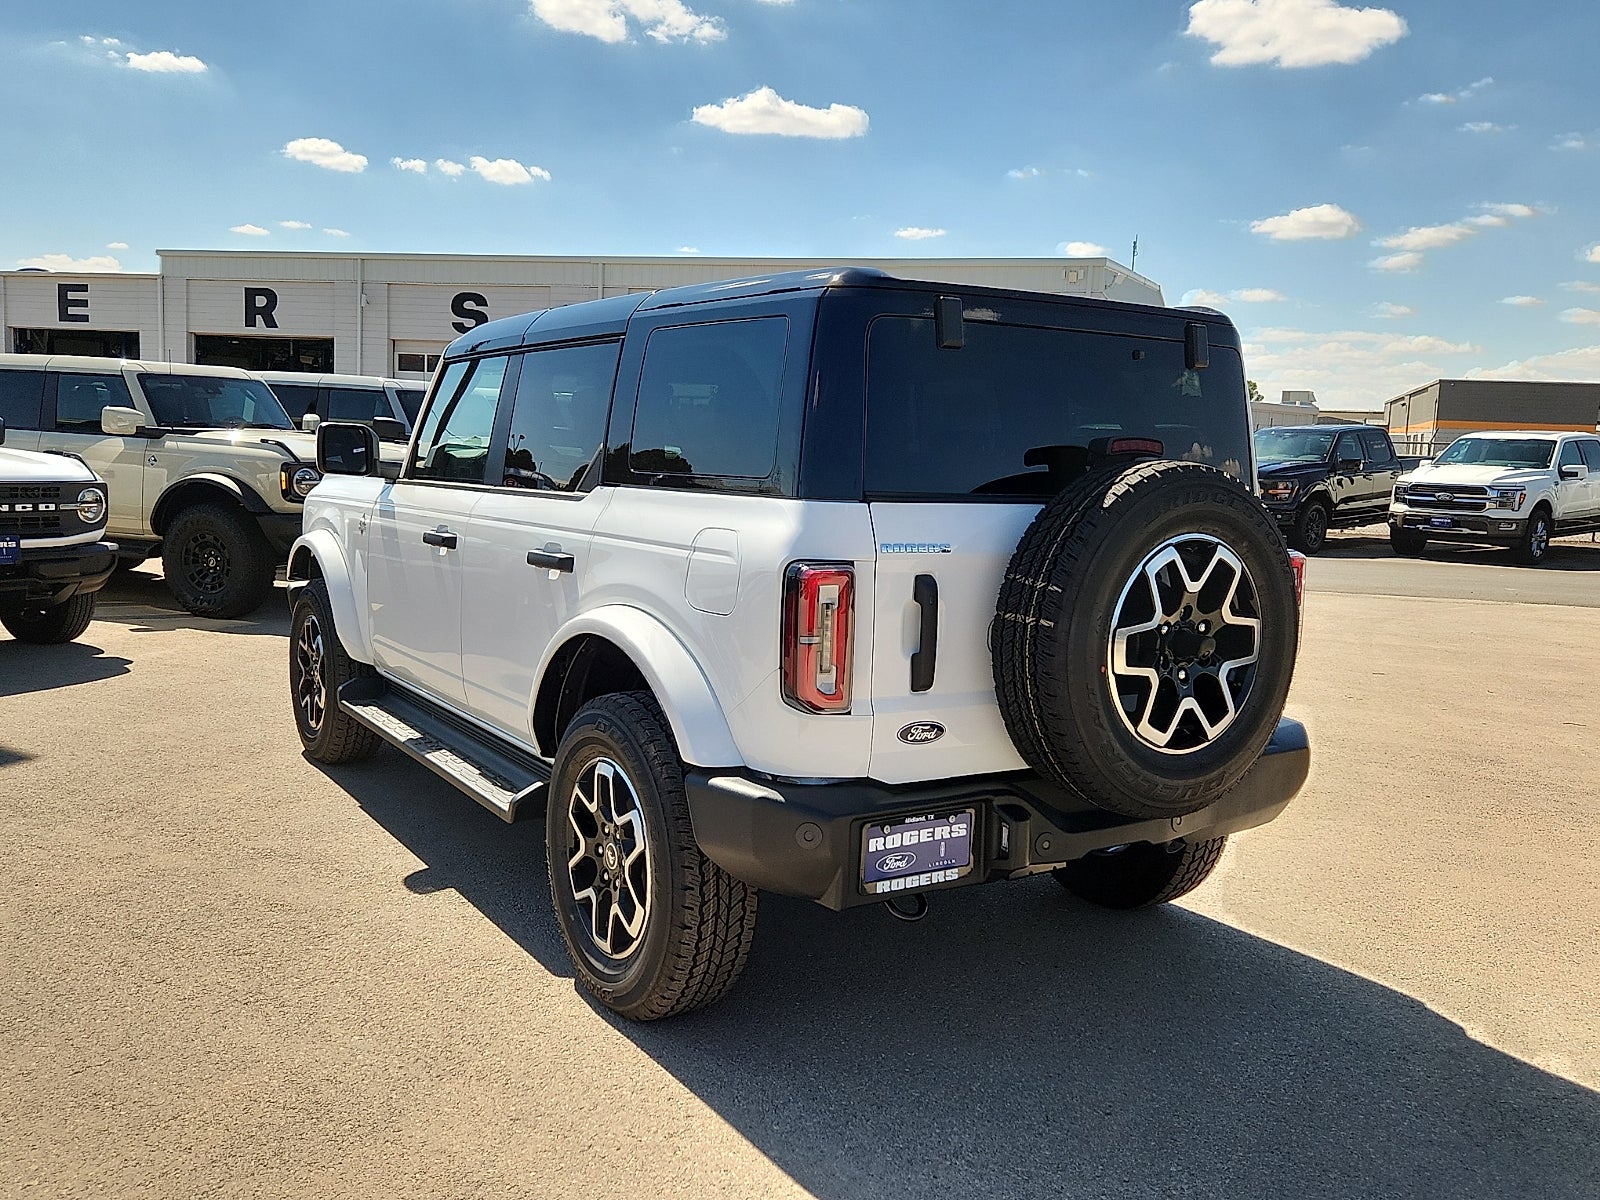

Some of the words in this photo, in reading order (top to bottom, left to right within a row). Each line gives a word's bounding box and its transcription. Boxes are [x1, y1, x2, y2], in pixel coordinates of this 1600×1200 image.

[57, 283, 90, 322] E
[244, 286, 279, 328] R
[450, 291, 490, 335] S
[880, 543, 952, 553] ROGERS
[907, 725, 938, 741] Ford
[868, 823, 968, 853] ROGERS
[883, 855, 909, 871] Ford
[876, 868, 959, 894] ROGERS
